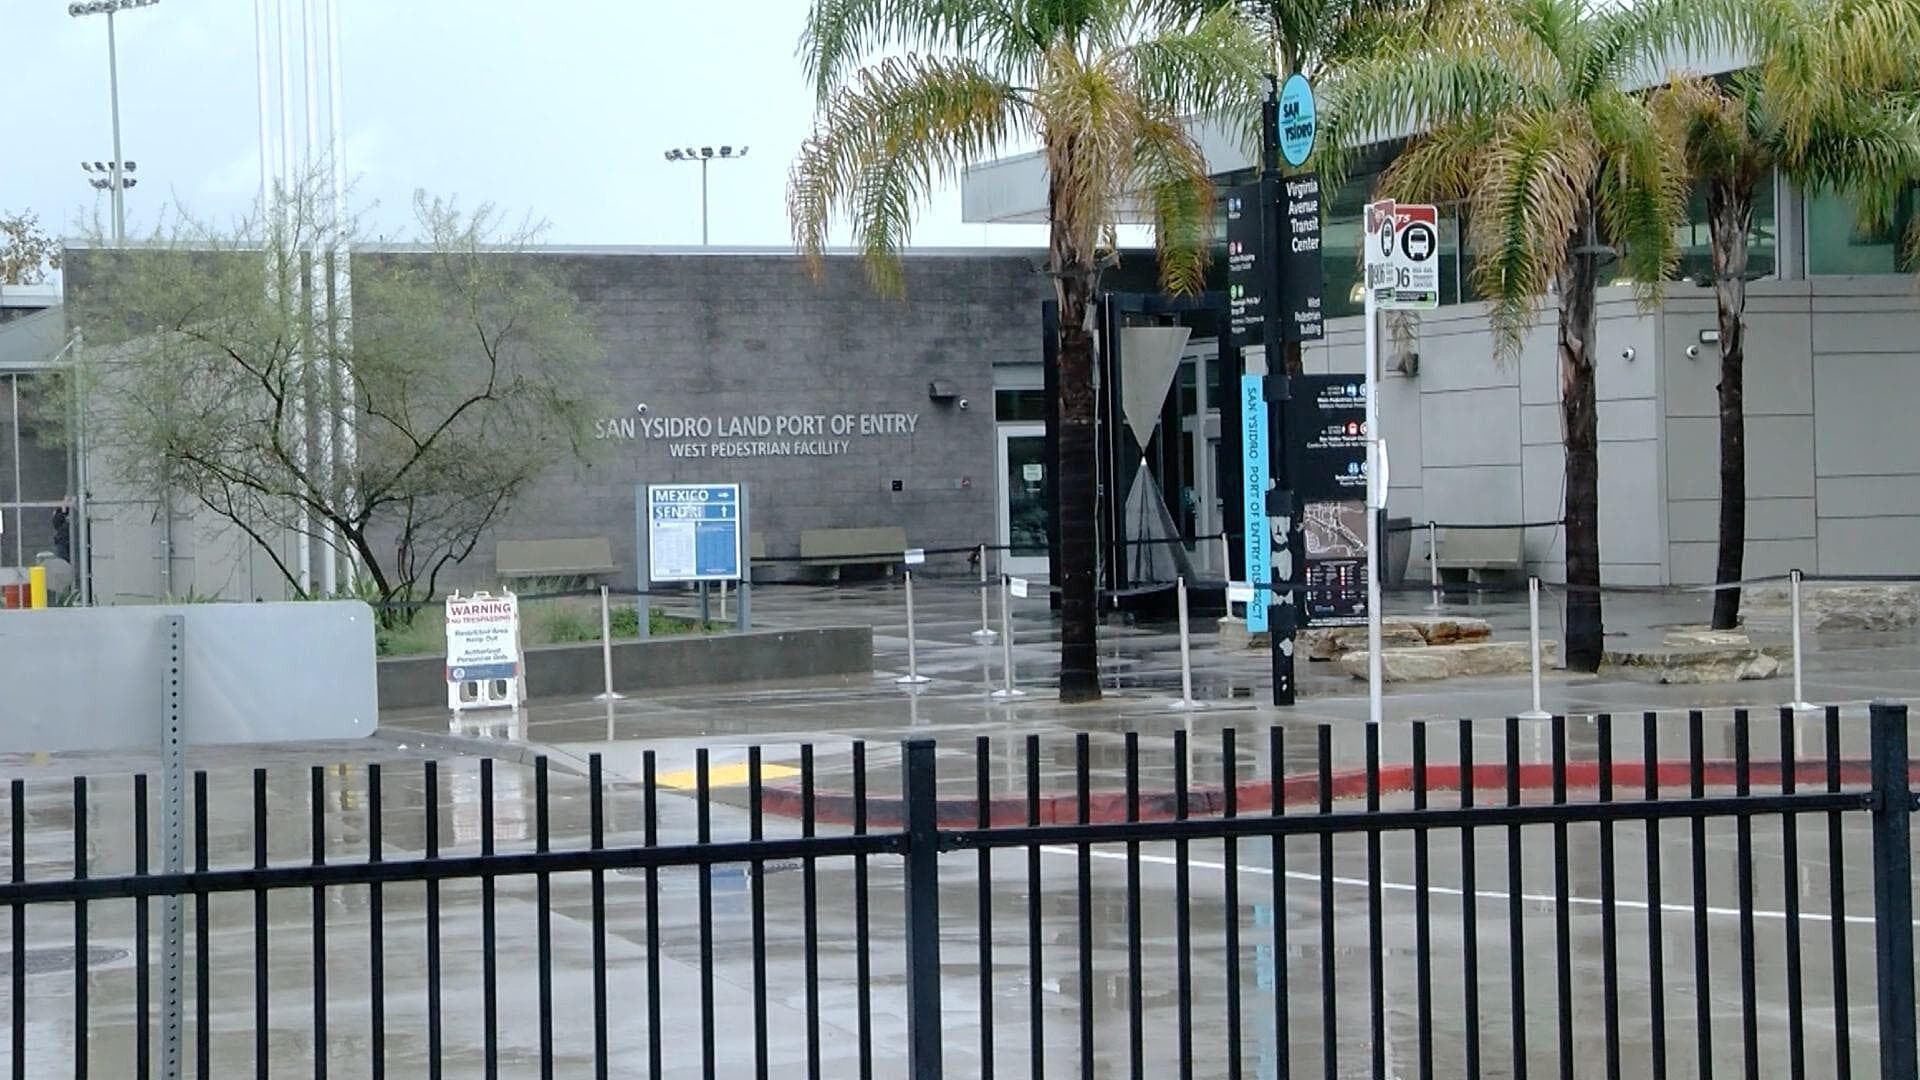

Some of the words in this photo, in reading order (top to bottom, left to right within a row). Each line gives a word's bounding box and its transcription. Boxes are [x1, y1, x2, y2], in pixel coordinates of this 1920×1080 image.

[1283, 101, 1300, 119] SAN
[1286, 179, 1318, 199] Virginia
[1288, 200, 1318, 215] Avenue
[1290, 216, 1318, 233] Transit
[1292, 237, 1319, 252] Center
[1247, 387, 1258, 411] SAN
[594, 417, 635, 441] SAN
[640, 416, 712, 439] YSIDRO
[717, 415, 772, 438] LAND
[776, 414, 825, 436] PORT
[830, 414, 855, 436] OF
[860, 413, 919, 435] ENTRY
[1248, 414, 1259, 459] YSIDRO
[669, 443, 707, 458] WEST
[711, 441, 791, 458] PEDESTRIAN
[794, 439, 849, 456] FACILITY
[1249, 466, 1260, 499] PORT
[655, 489, 709, 502] MEXICO
[1250, 502, 1260, 518] OF
[1251, 522, 1261, 560] ENTRY
[451, 603, 511, 616] WARNING
[485, 634, 498, 642] Out
